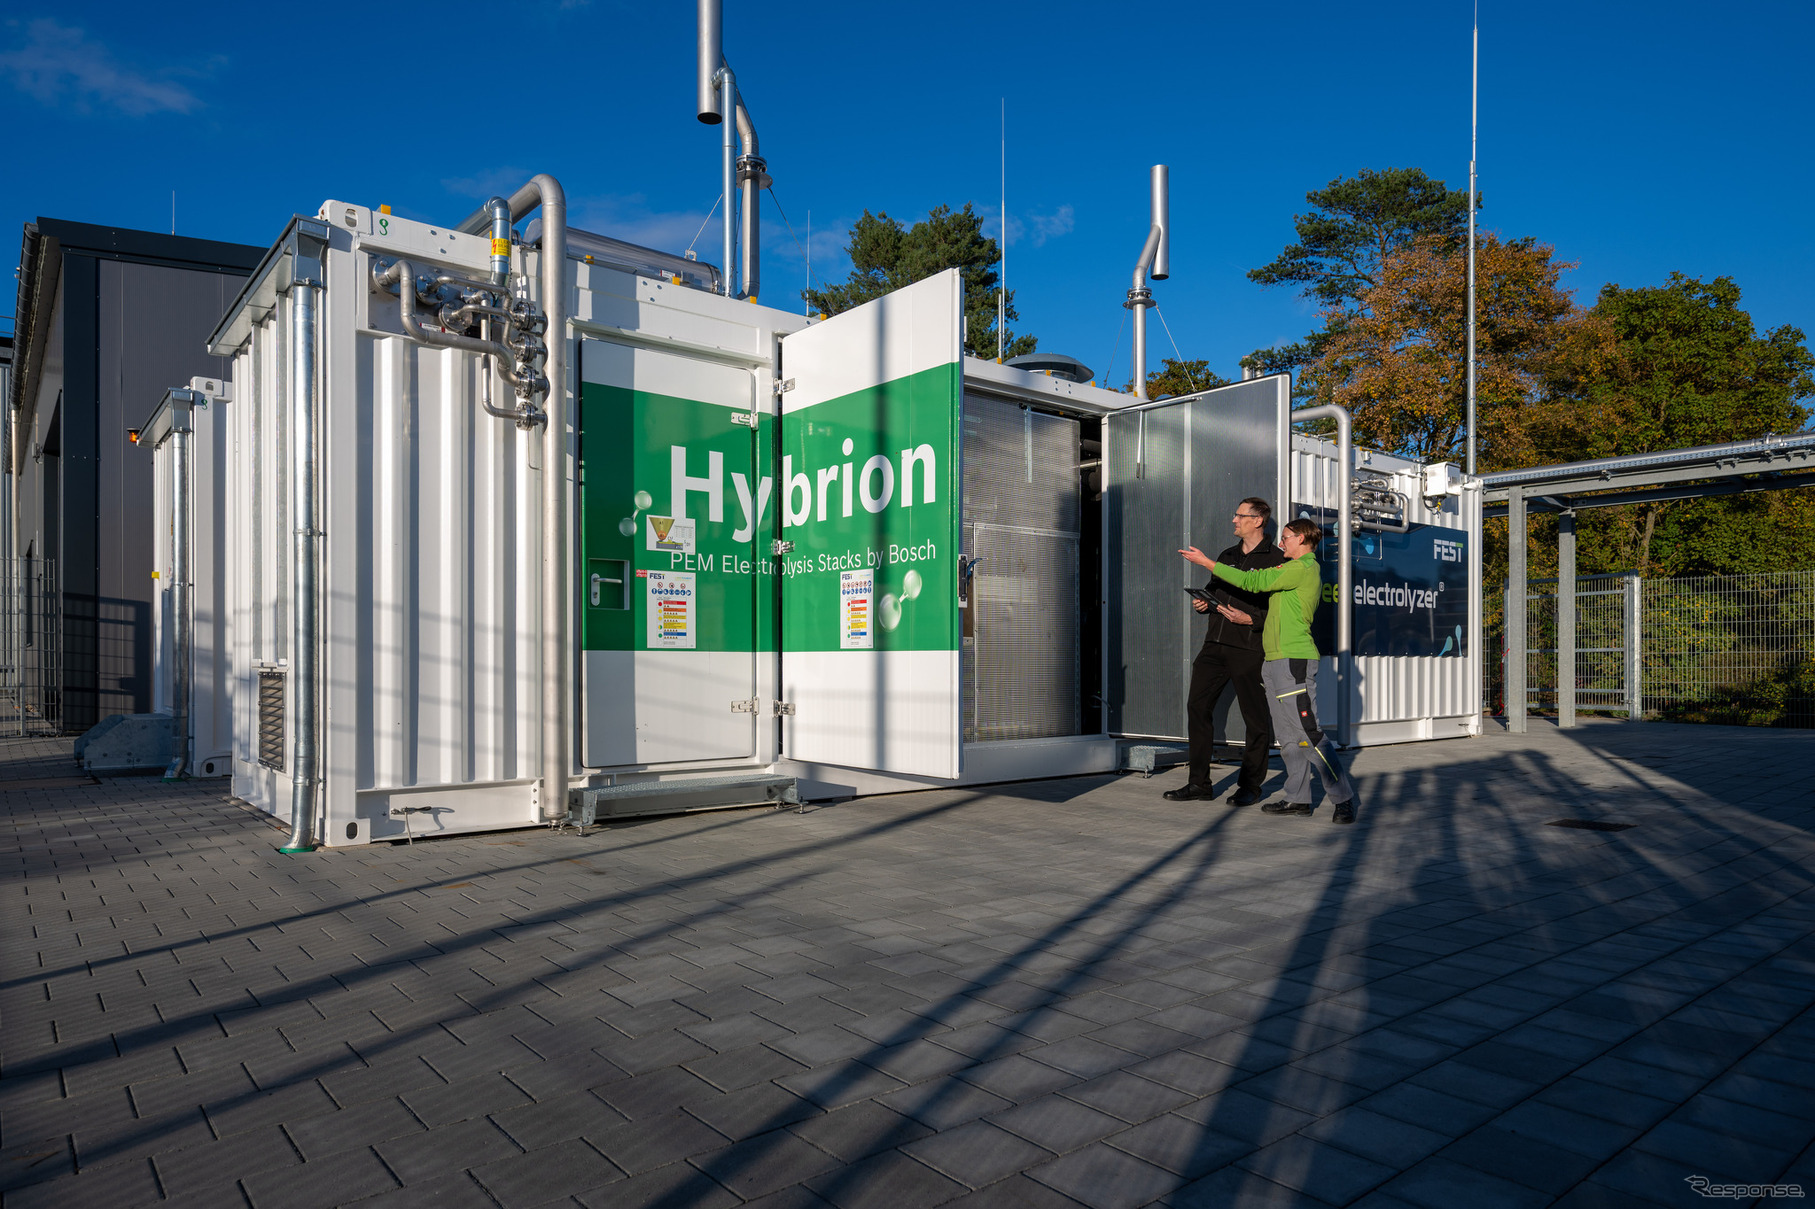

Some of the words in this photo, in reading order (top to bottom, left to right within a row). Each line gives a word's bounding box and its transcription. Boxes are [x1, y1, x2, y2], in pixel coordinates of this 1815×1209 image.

[671, 438, 936, 543] Hybrion
[670, 552, 714, 573] PEM
[722, 552, 814, 579] Electrolysis
[818, 550, 862, 571] Stacks
[867, 546, 884, 570] by
[889, 538, 936, 564] Bosch
[1433, 538, 1464, 563] FEST
